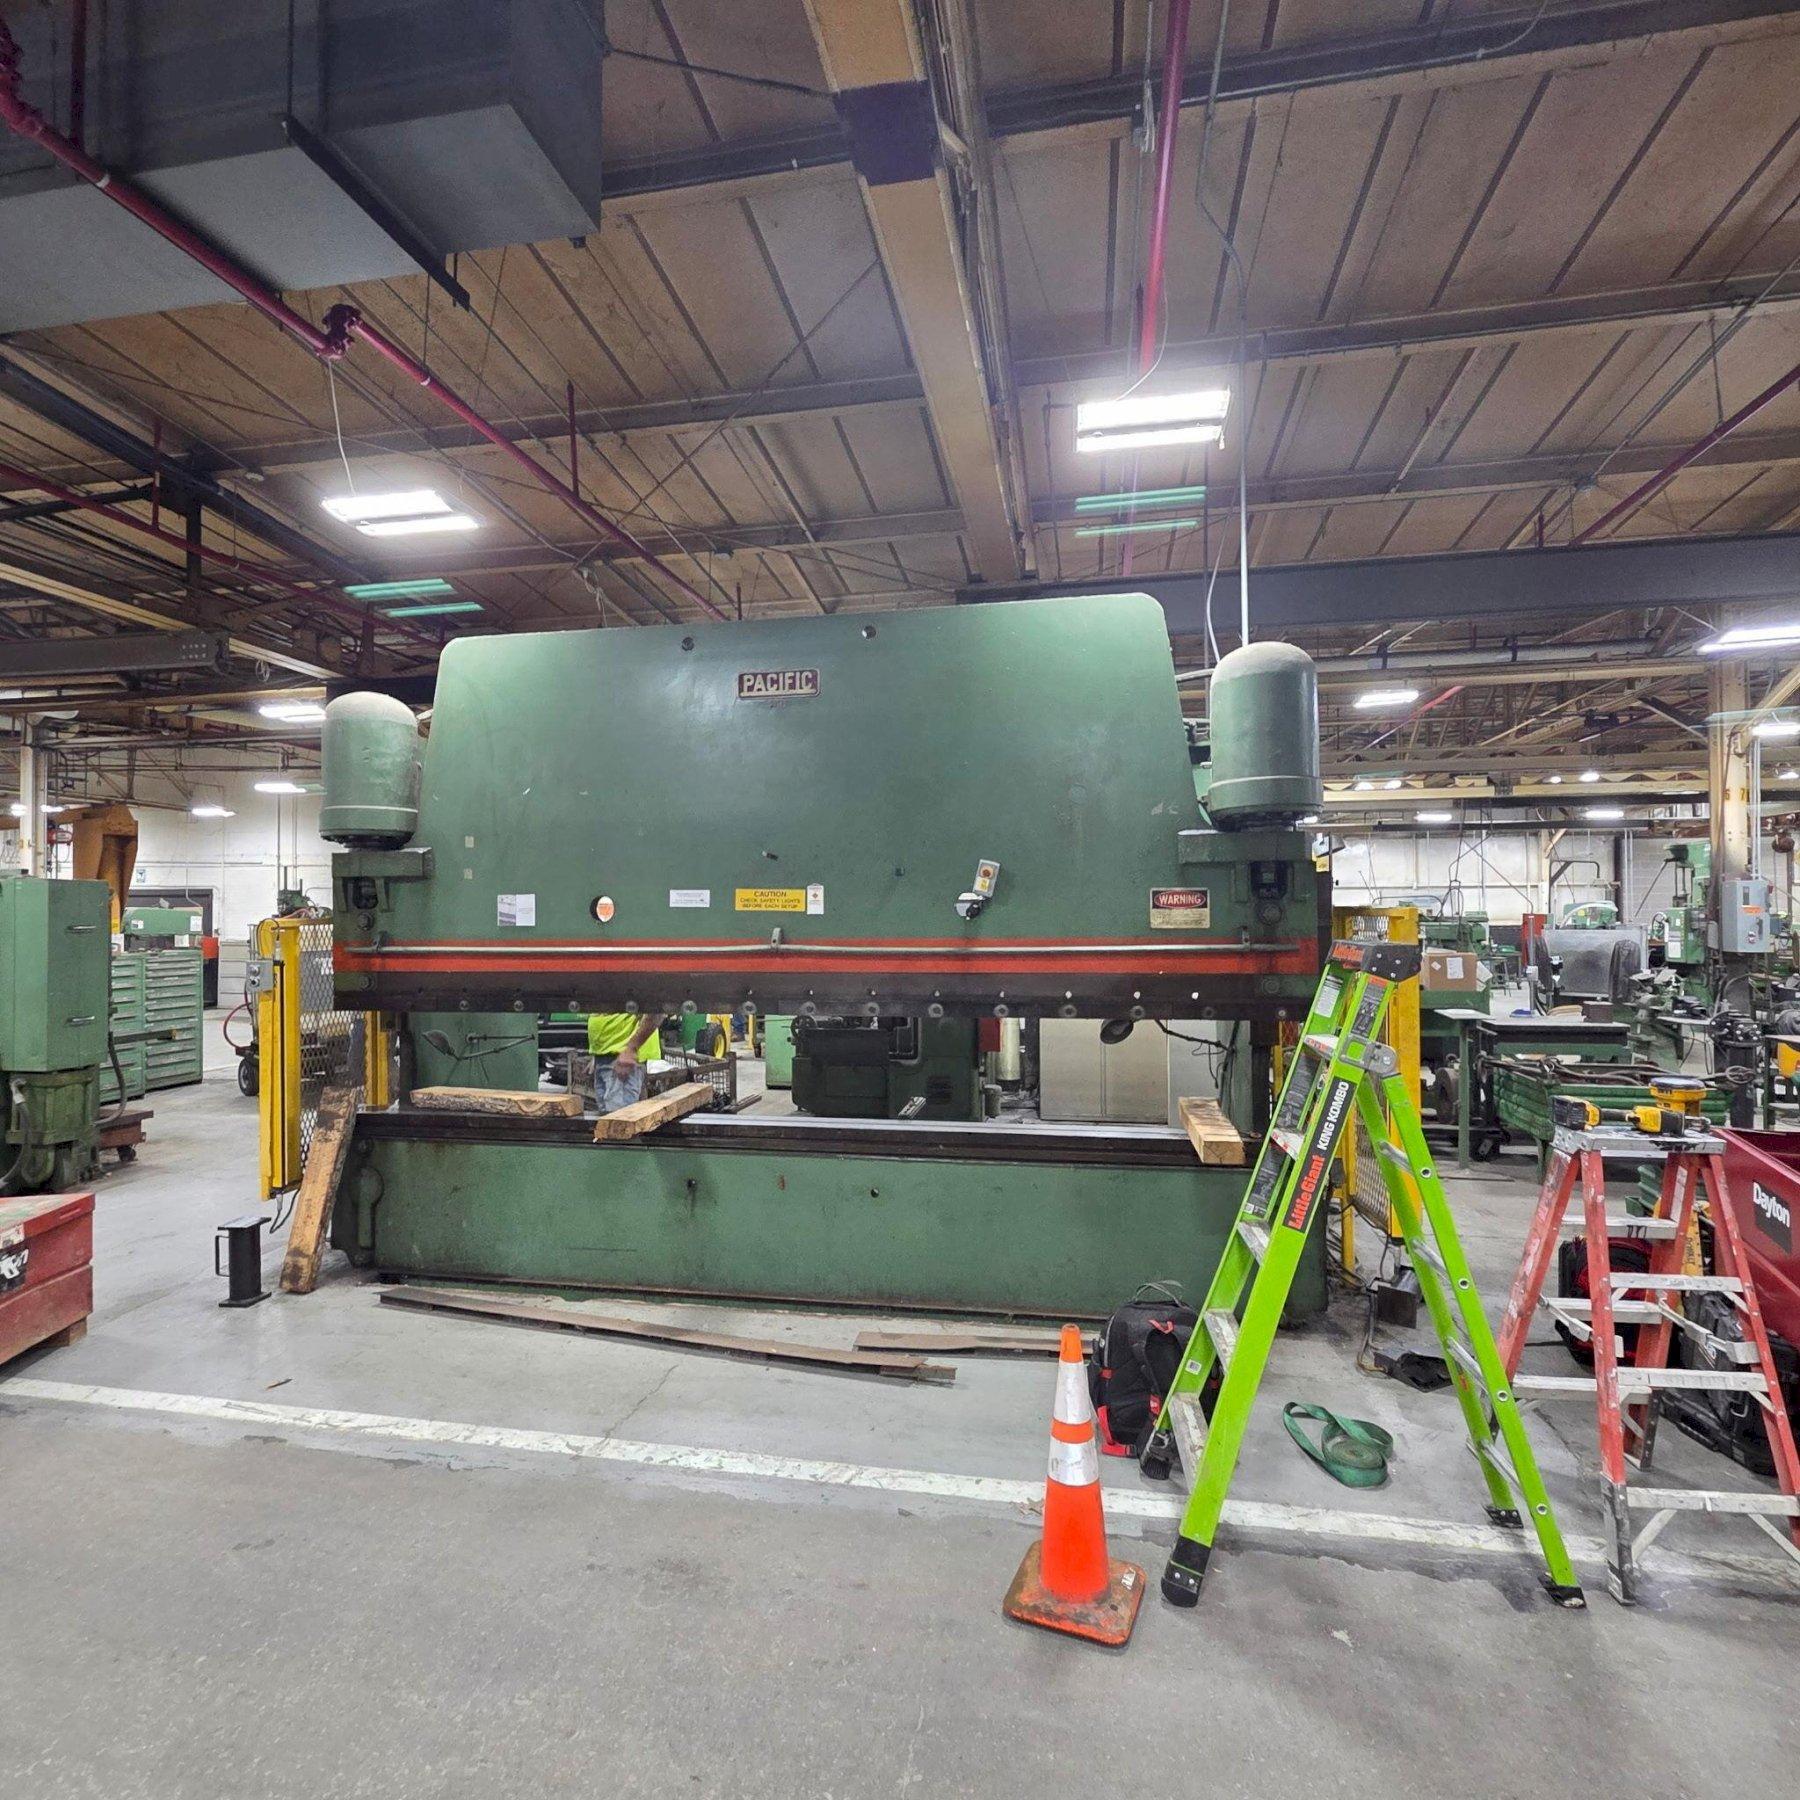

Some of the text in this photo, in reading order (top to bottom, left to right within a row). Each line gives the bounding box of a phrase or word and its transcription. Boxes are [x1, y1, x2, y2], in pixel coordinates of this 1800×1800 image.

[743, 671, 812, 692] PACIFIC
[1159, 894, 1201, 904] WARNING
[1317, 1122, 1336, 1150] KING
[1327, 1081, 1349, 1123] KOMBO
[1753, 1181, 1790, 1228] Dayton
